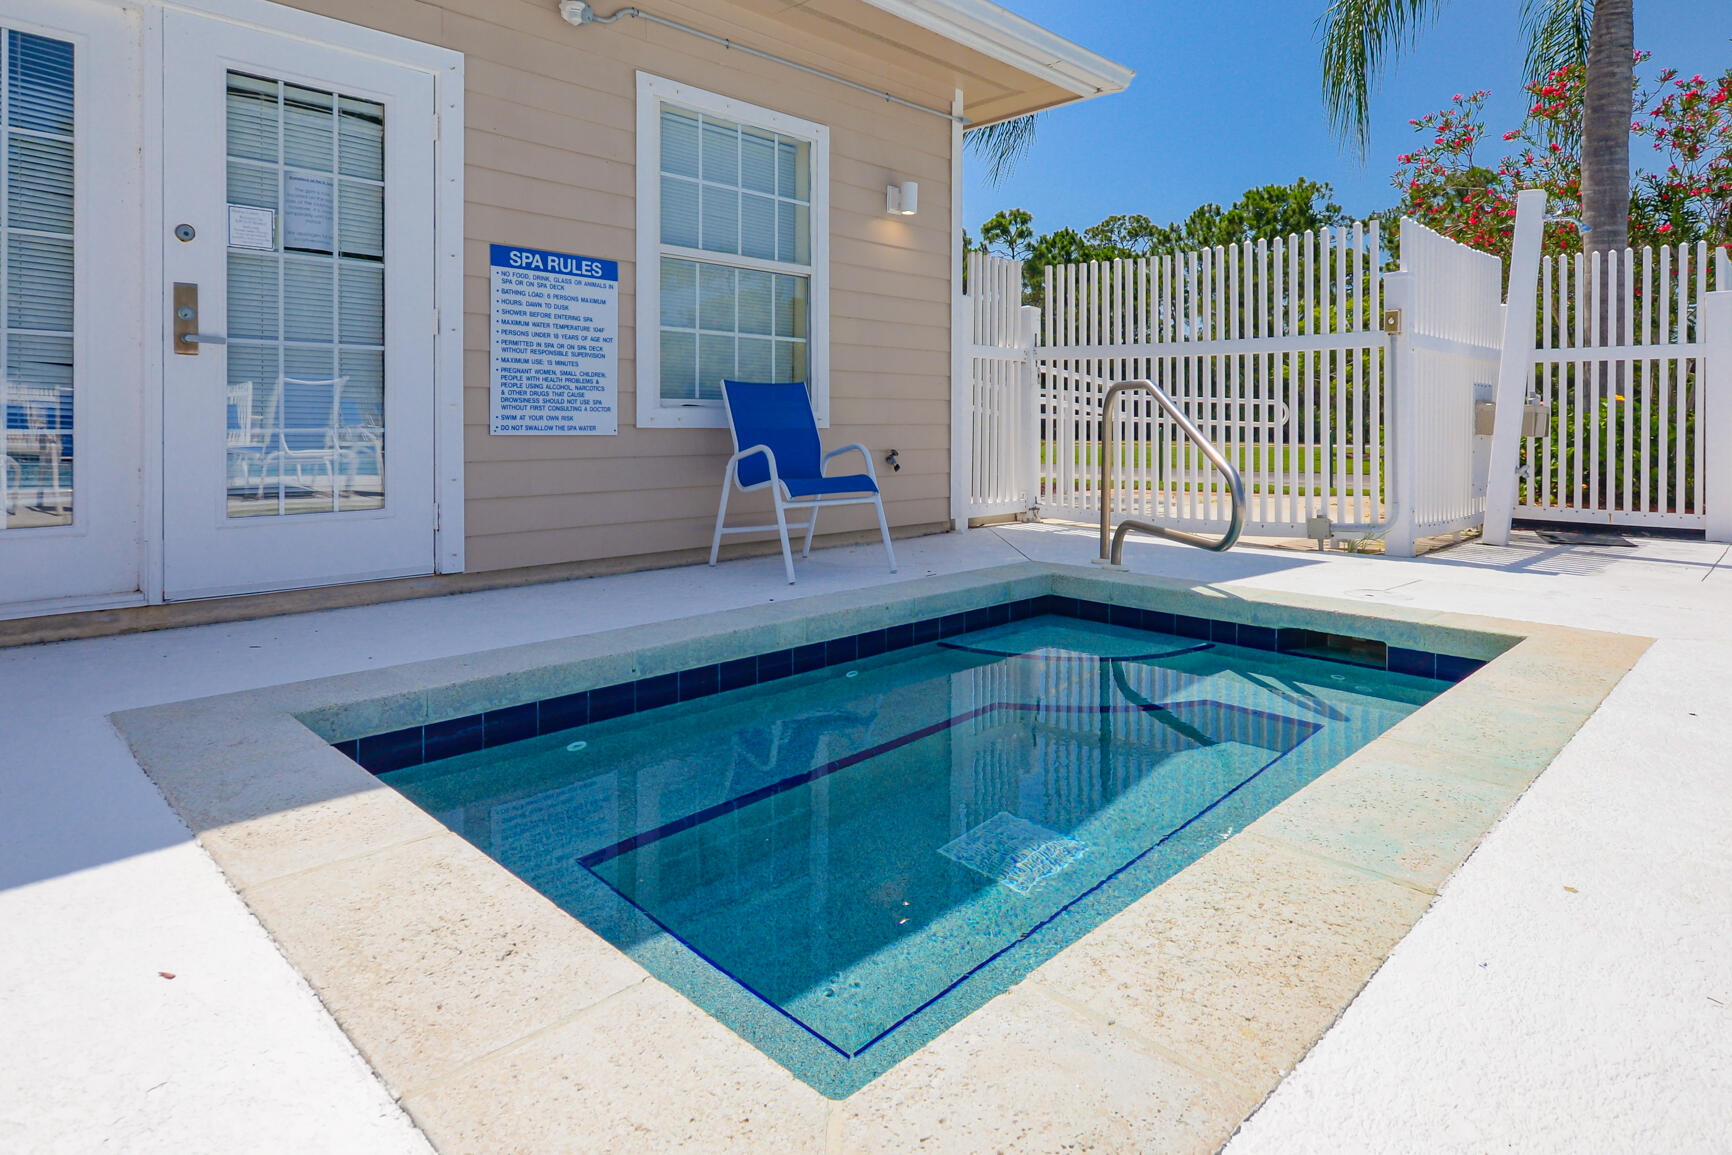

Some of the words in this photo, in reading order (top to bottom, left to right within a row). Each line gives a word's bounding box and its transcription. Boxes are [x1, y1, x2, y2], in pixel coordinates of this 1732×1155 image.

[510, 251, 543, 269] SPA
[548, 256, 602, 276] RULES
[553, 323, 590, 332] TEMPERATURE
